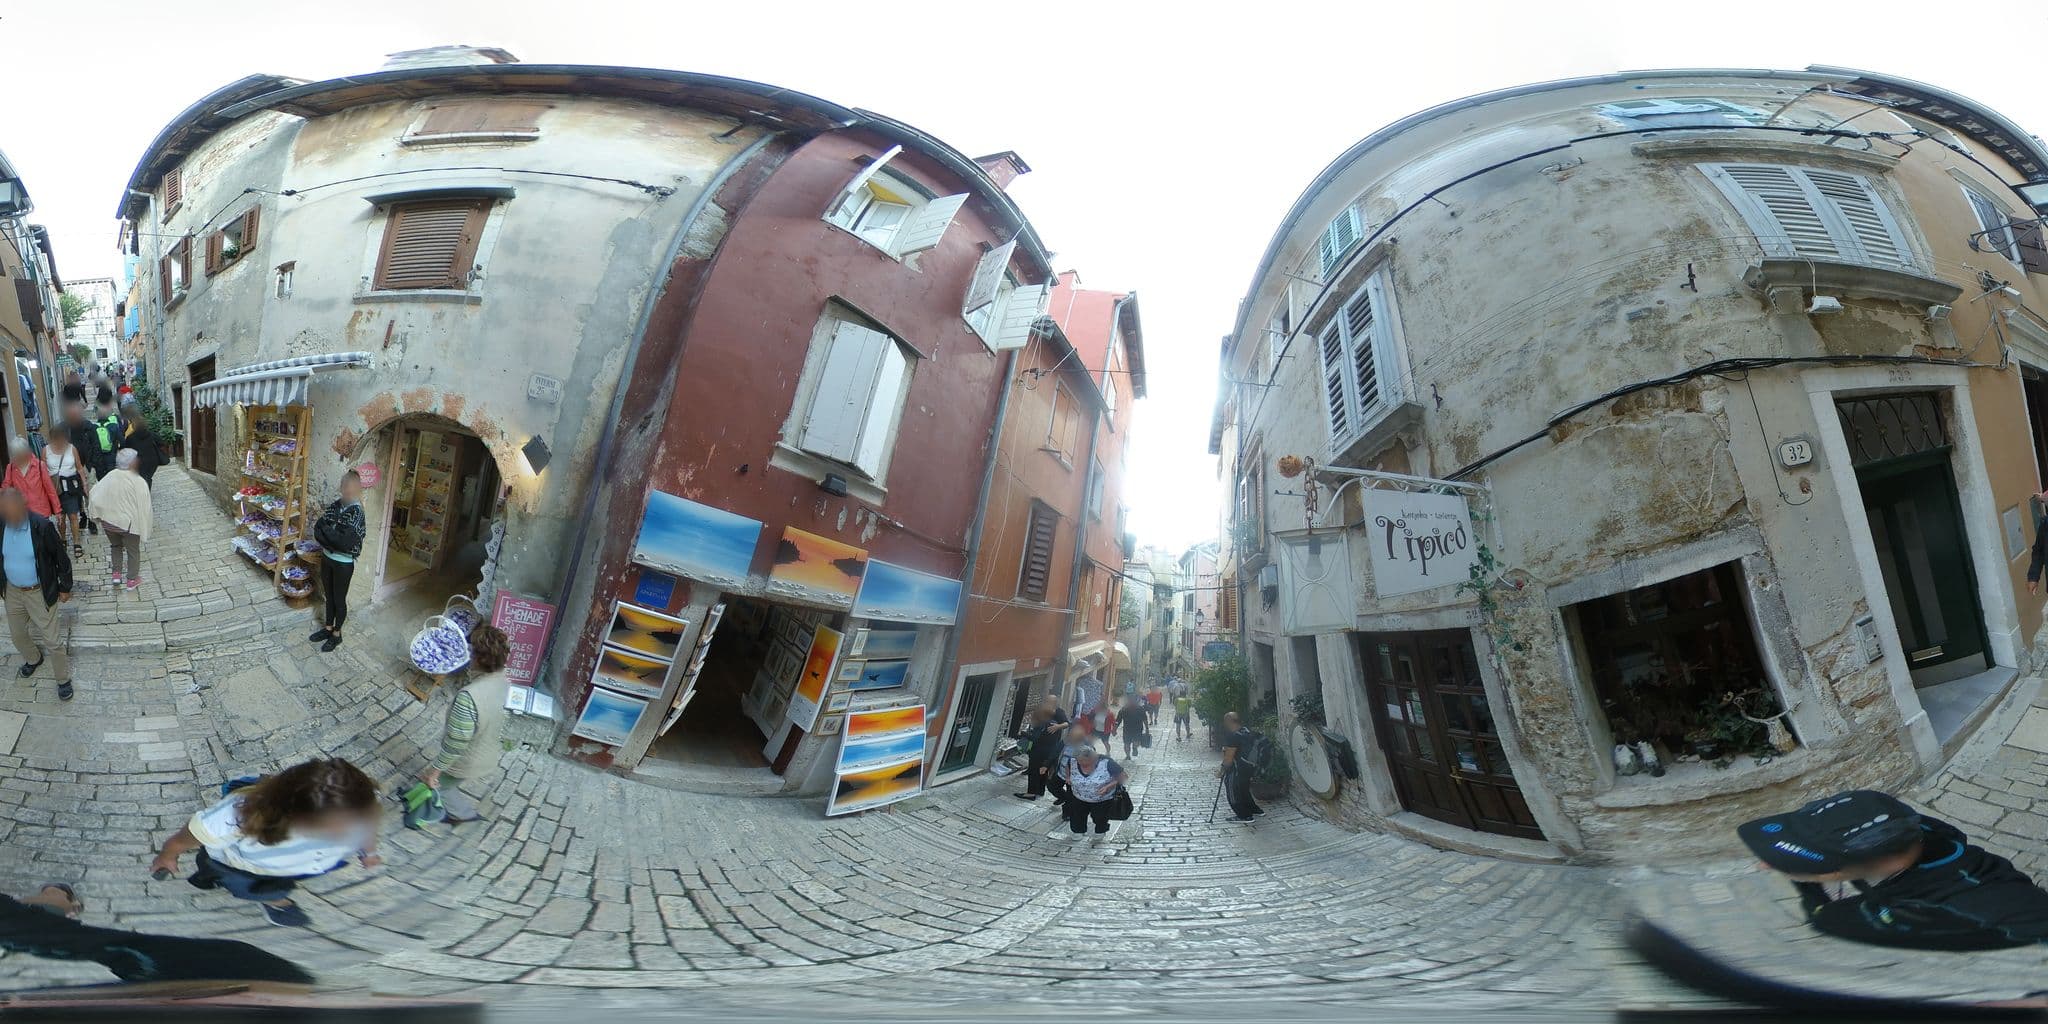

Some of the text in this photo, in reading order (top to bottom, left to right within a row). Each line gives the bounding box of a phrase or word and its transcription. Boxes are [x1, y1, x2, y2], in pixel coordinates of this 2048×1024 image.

[1789, 444, 1805, 461] 32
[1375, 515, 1467, 577] Tipico
[511, 659, 528, 669] SET
[513, 651, 532, 663] SALT
